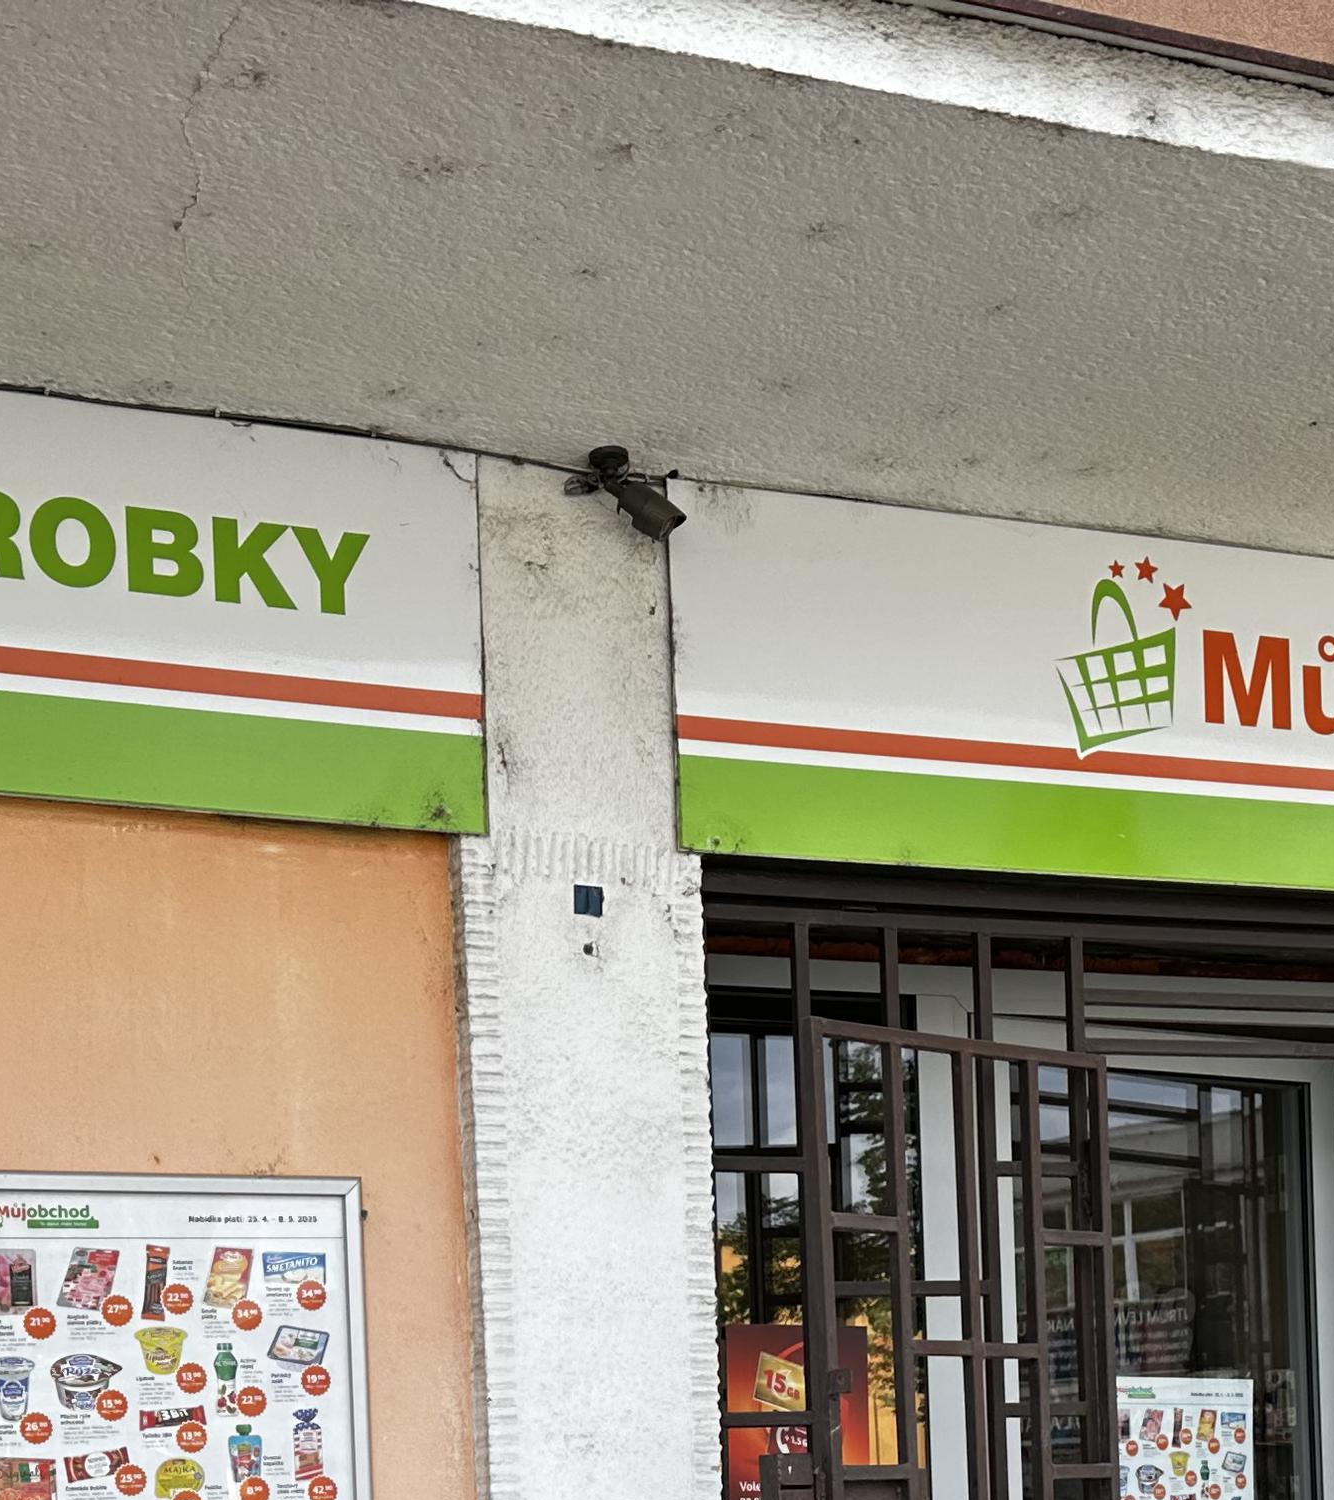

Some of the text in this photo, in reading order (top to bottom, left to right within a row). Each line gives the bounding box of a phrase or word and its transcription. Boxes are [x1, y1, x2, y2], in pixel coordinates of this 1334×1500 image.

[266, 1256, 318, 1273] SMETANITO
[763, 1368, 787, 1394] 15
[163, 1465, 197, 1474] MAJKA
